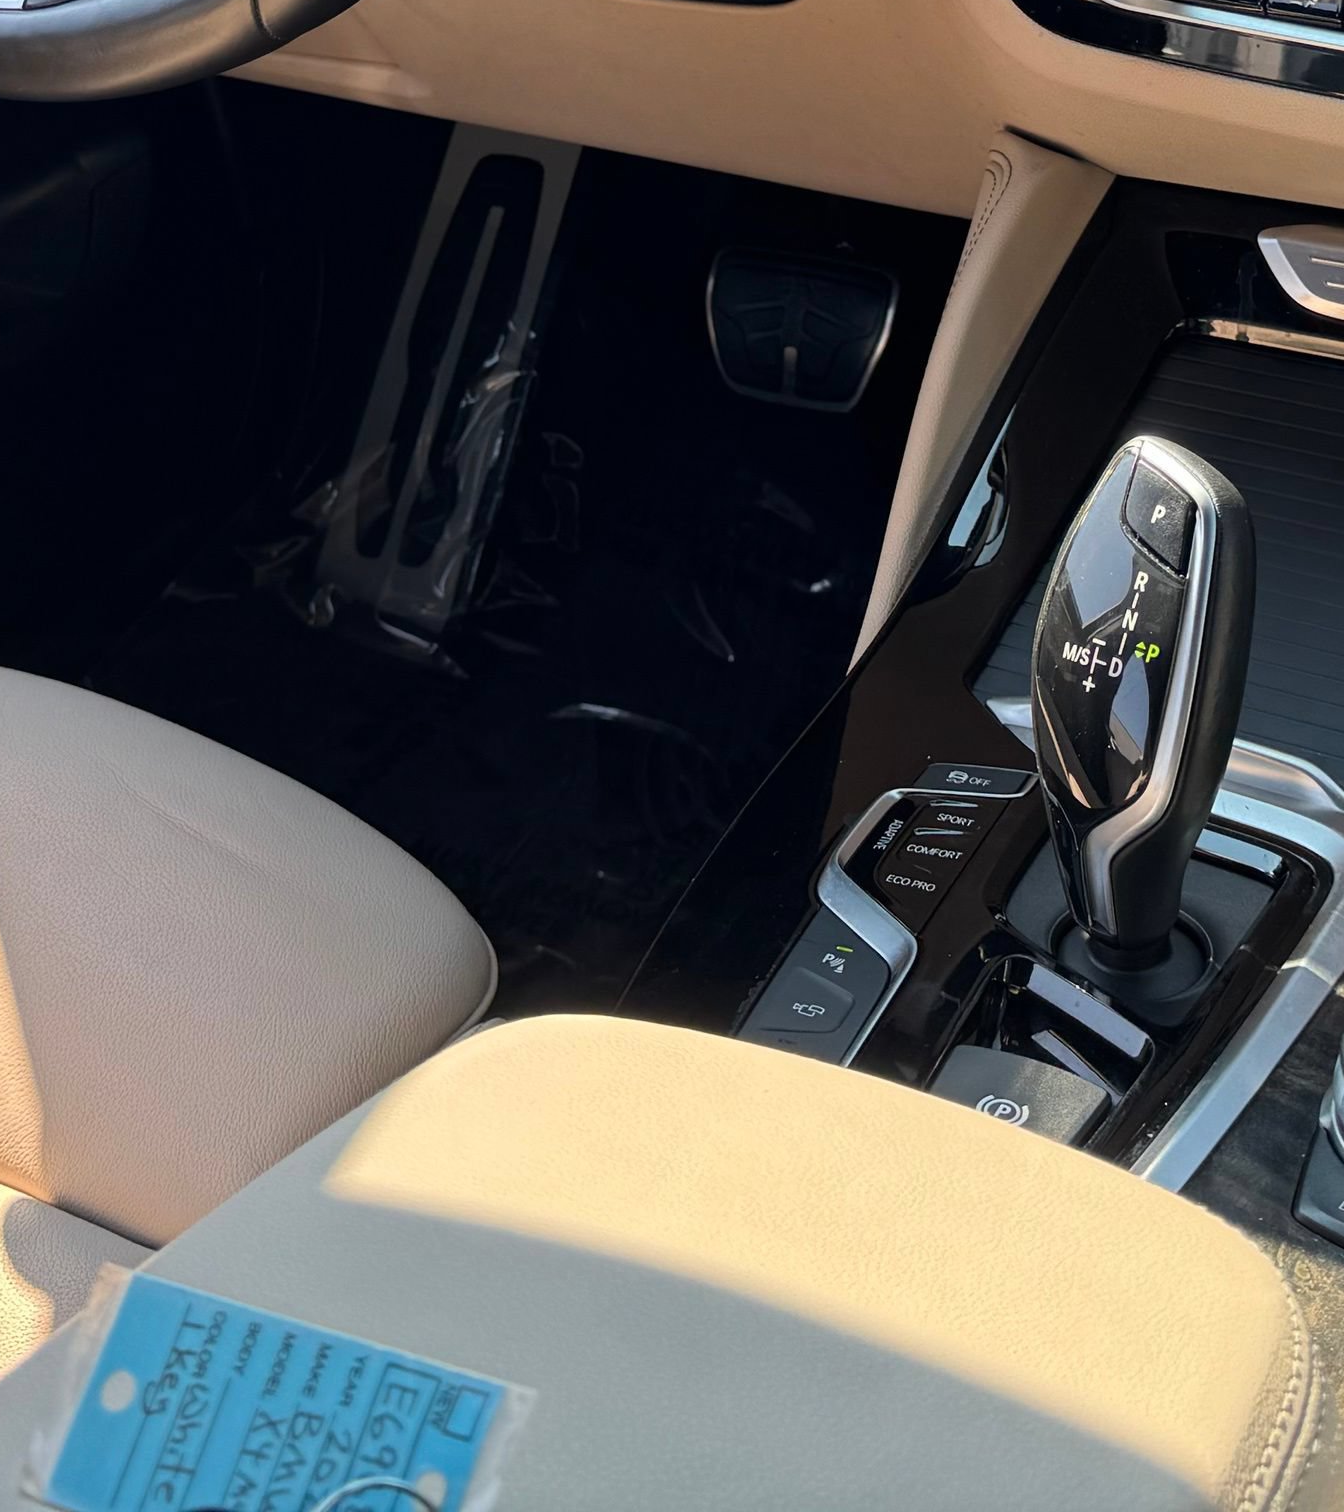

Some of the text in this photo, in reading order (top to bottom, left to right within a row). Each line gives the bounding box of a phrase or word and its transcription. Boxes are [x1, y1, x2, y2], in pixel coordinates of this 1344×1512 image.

[1150, 504, 1166, 524] P
[1133, 570, 1149, 593] R
[1121, 609, 1139, 631] N
[1062, 641, 1091, 666] M/S
[1145, 645, 1161, 664] P
[1108, 656, 1123, 678] D
[969, 776, 992, 787] OFF
[936, 812, 975, 828] SPORT
[873, 819, 904, 851] ADAPTIVE
[906, 843, 963, 861] COMFORT
[885, 873, 936, 893] ECO PRO
[192, 1309, 227, 1379] COLOR
[233, 1321, 262, 1377] BODY
[262, 1332, 297, 1399] MODEL
[302, 1341, 333, 1399] MAKE
[340, 1355, 369, 1408] YEAR
